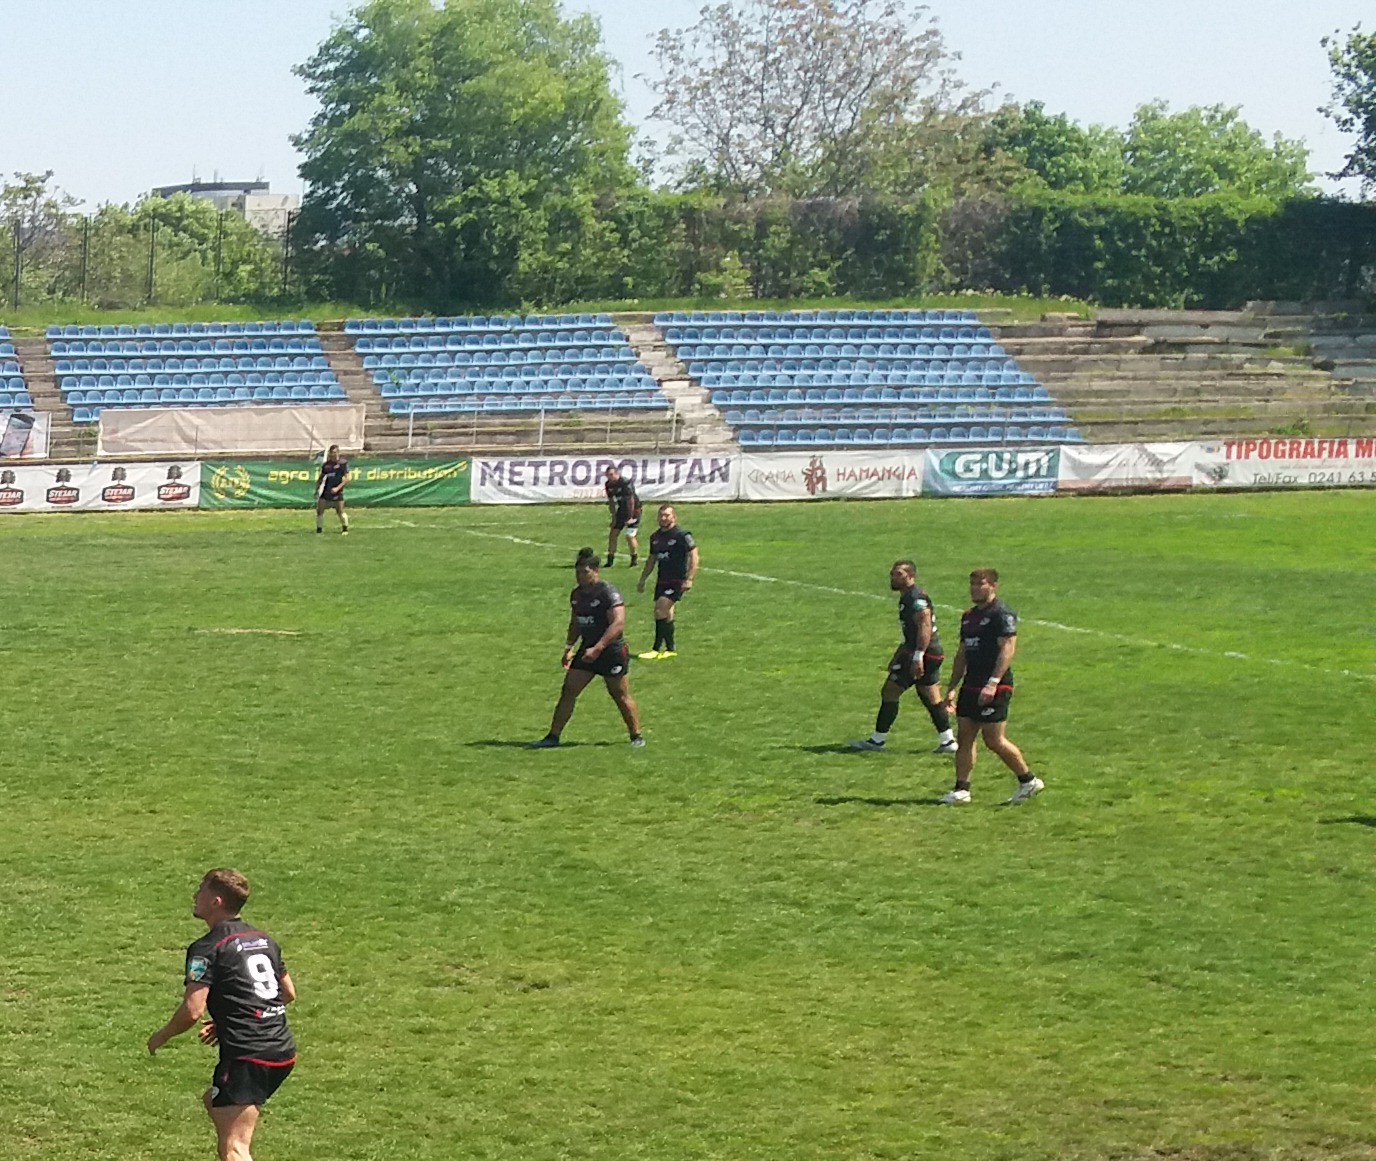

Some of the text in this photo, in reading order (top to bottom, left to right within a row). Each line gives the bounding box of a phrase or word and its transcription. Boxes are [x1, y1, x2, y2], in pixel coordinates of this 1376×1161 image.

[1223, 438, 1376, 460] TIPOGRAFIA M
[268, 470, 307, 485] agro
[1308, 471, 1341, 484] 0241
